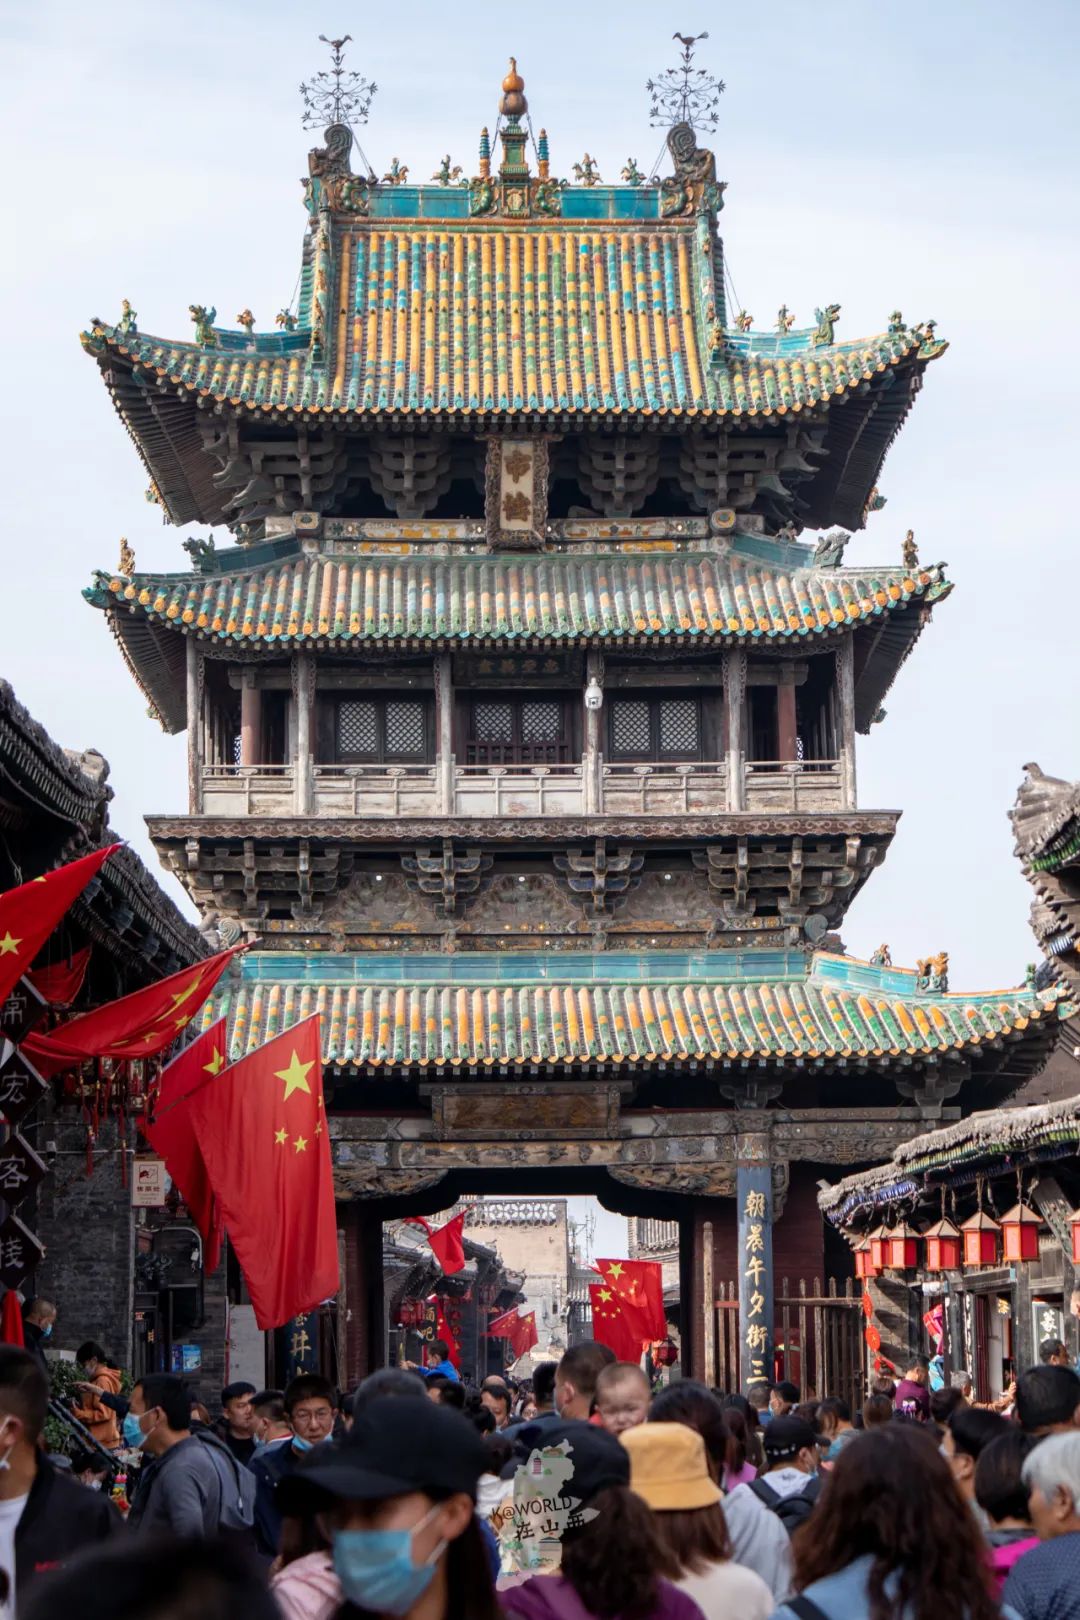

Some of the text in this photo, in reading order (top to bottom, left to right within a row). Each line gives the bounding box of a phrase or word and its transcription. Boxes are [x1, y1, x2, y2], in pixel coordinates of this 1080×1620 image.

[744, 1190, 768, 1385] 朝晨午夕街三
